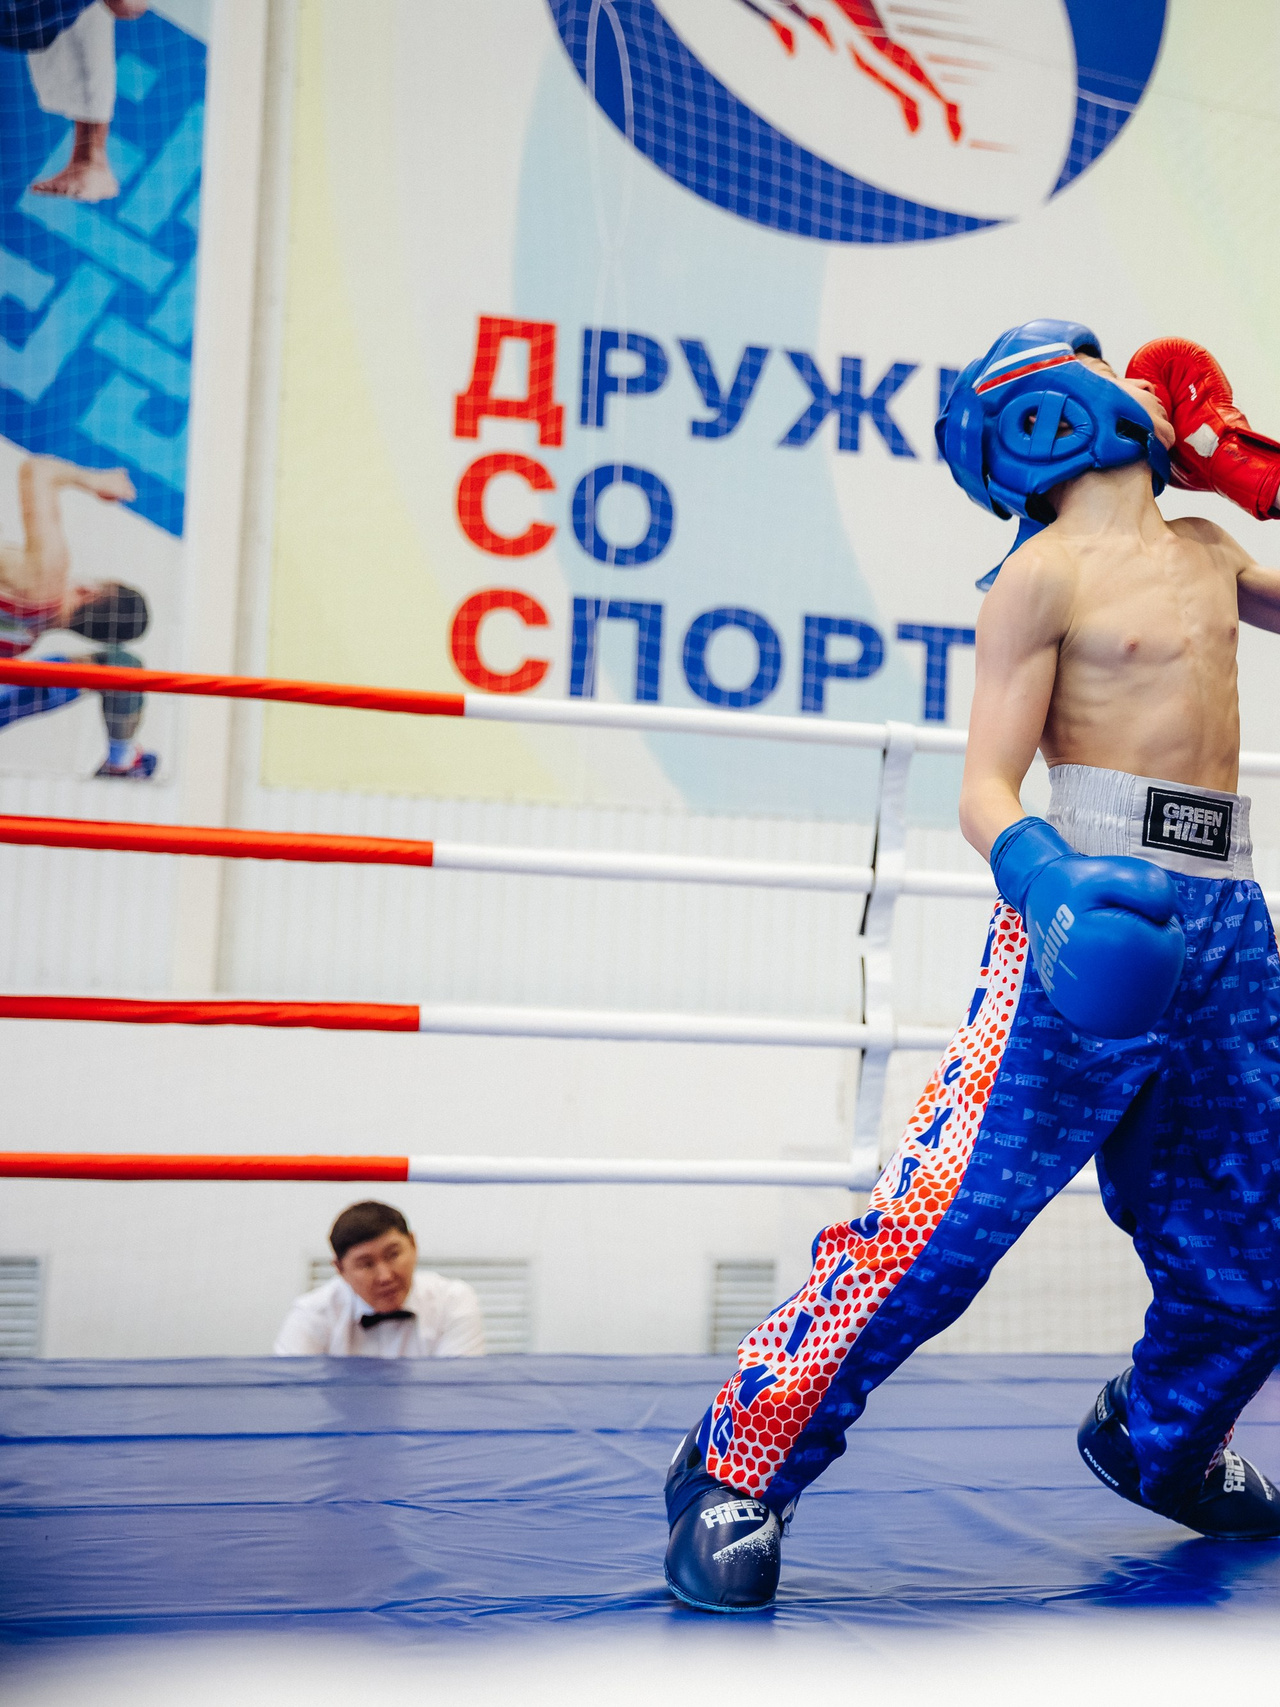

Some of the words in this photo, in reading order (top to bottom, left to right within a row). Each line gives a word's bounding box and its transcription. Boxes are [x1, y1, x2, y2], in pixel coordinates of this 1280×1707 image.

[452, 313, 964, 462] ДРУЖ
[455, 451, 676, 569] СО
[1162, 802, 1223, 828] GREEN
[1162, 818, 1214, 846] HILL
[994, 1131, 1028, 1143] GREEN
[994, 1138, 1023, 1149] HILL
[973, 1190, 1006, 1203] GREEN
[973, 1198, 1001, 1209] HILL
[1083, 1447, 1120, 1487] PANTHER
